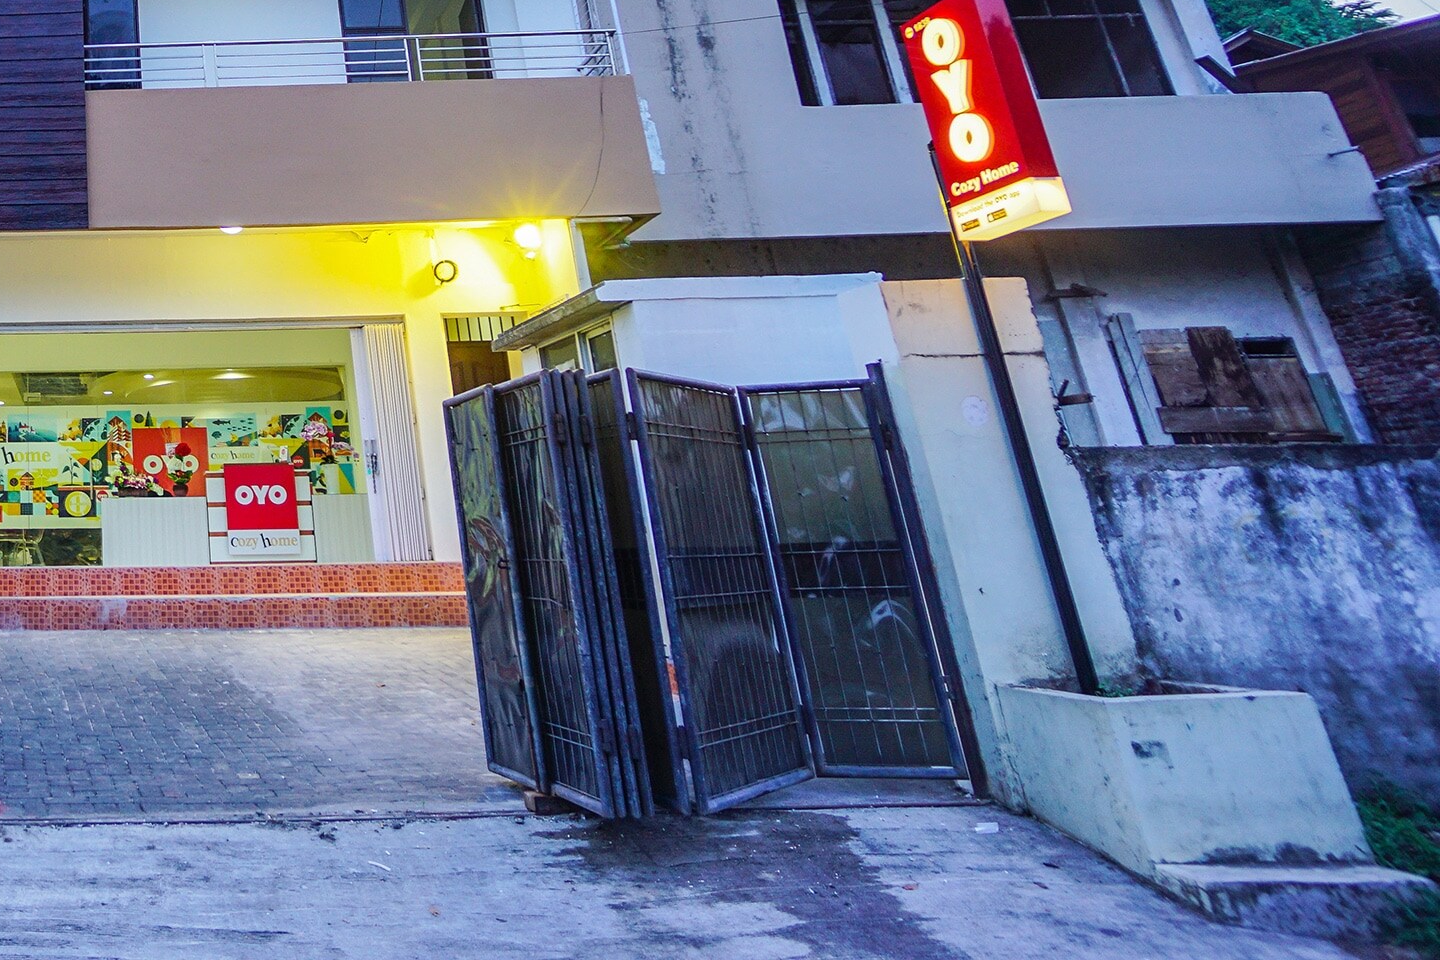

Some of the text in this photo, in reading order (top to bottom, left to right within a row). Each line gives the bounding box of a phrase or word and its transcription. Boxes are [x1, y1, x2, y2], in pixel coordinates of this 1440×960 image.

[922, 18, 994, 162] OYO
[951, 161, 1019, 196] Cozy Home
[1, 446, 51, 465] home
[210, 450, 255, 460] cozy home
[234, 485, 288, 505] OYO
[230, 533, 298, 551] cozy home
